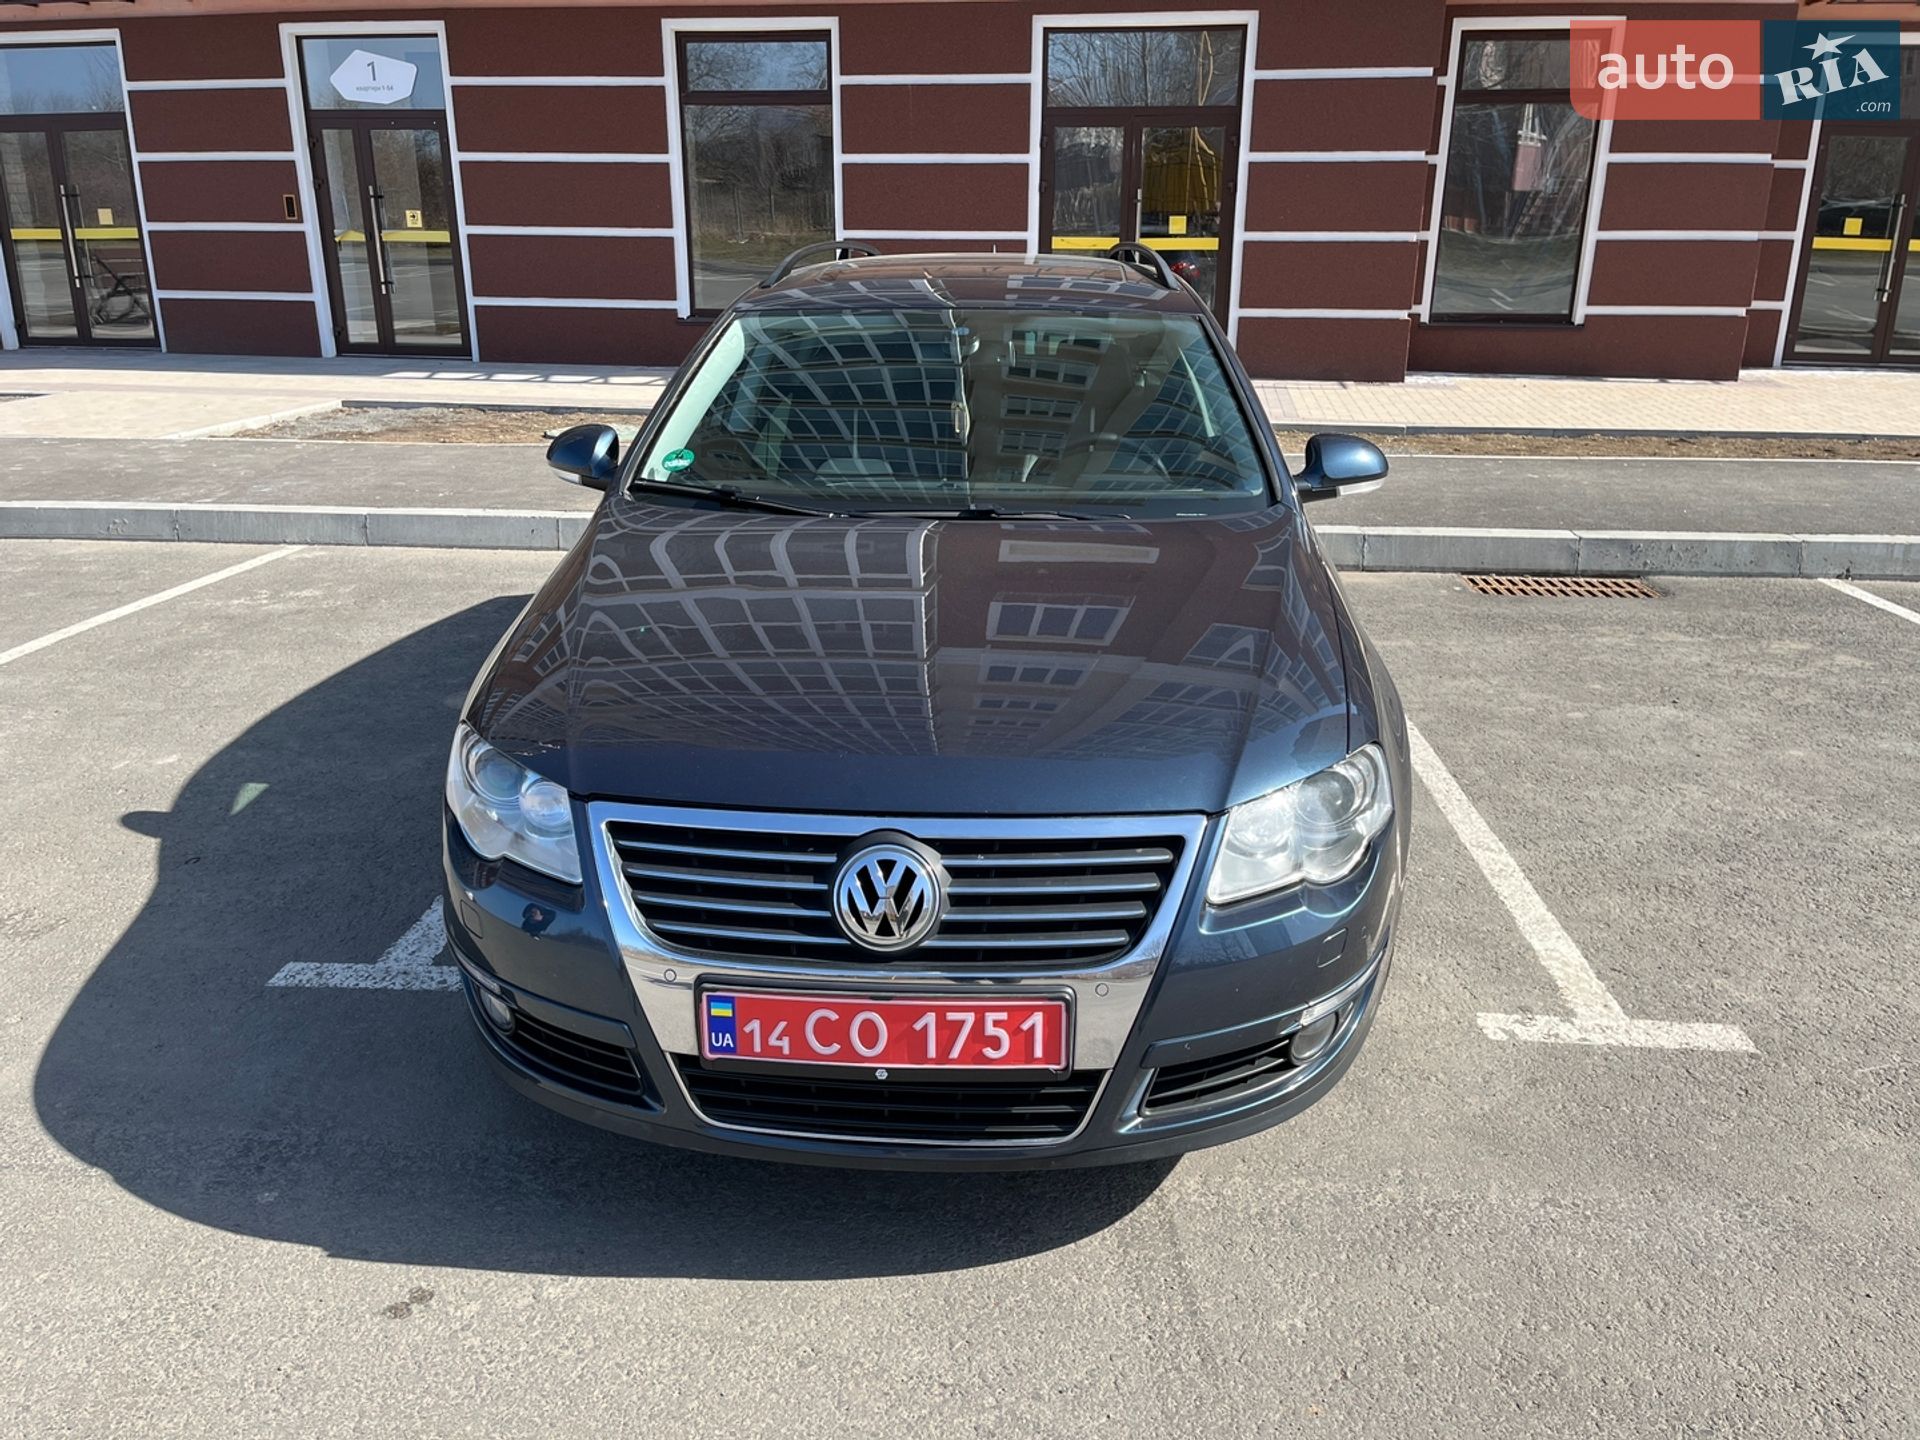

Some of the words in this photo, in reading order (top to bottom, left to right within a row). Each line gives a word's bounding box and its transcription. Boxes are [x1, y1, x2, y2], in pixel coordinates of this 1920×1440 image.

[367, 61, 376, 81] 1
[711, 1031, 734, 1048] UA
[743, 1018, 790, 1055] 14
[912, 1011, 1044, 1059] 1751
